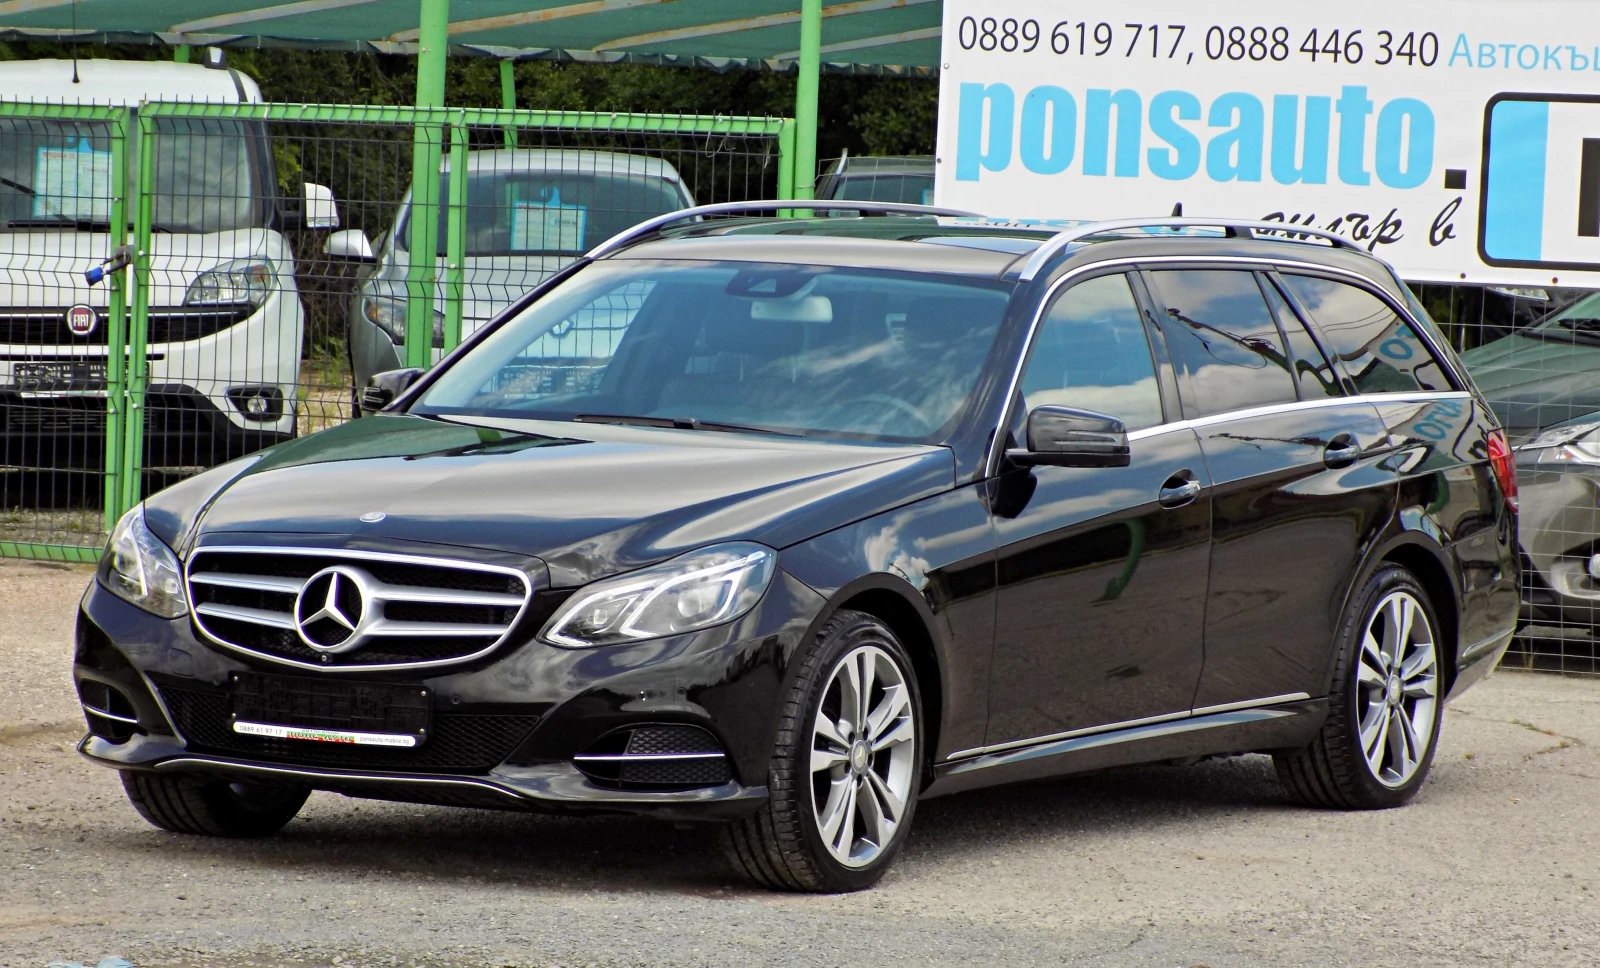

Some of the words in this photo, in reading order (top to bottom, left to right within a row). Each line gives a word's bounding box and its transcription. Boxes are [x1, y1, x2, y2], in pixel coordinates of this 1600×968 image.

[958, 16, 1040, 53] 0889
[1050, 20, 1113, 57] 619
[1124, 23, 1194, 64] 717,
[1205, 25, 1290, 62] 0888
[1299, 28, 1364, 65] 446
[1374, 30, 1440, 67] 340
[73, 314, 89, 327] FIAT
[239, 725, 255, 733] 0889
[359, 736, 410, 746] ponsauto.mobile.bg
